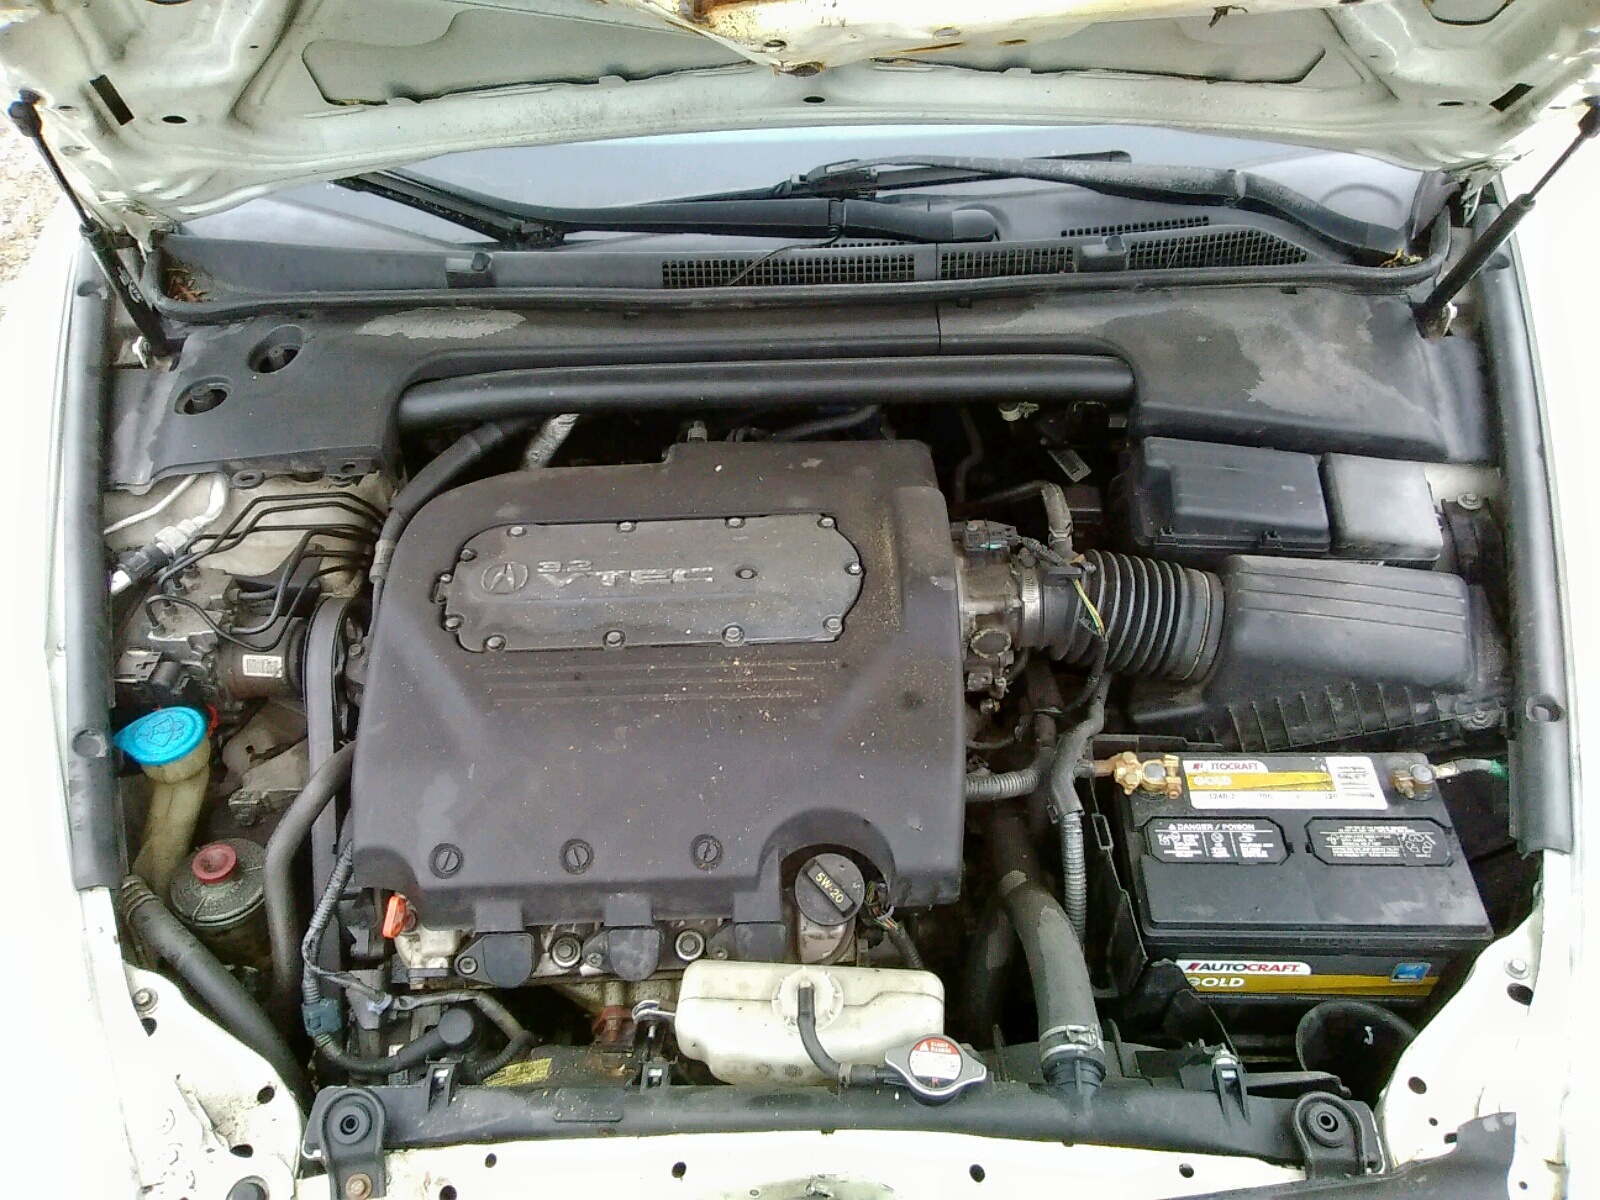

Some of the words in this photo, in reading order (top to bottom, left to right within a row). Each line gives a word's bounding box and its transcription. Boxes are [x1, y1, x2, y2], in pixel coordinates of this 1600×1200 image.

[538, 567, 714, 588] VTEC
[1177, 823, 1213, 831] DANGER
[1221, 823, 1256, 831] POISON
[1198, 962, 1300, 973] AUTOCRAFT
[1187, 977, 1246, 988] GOLD
